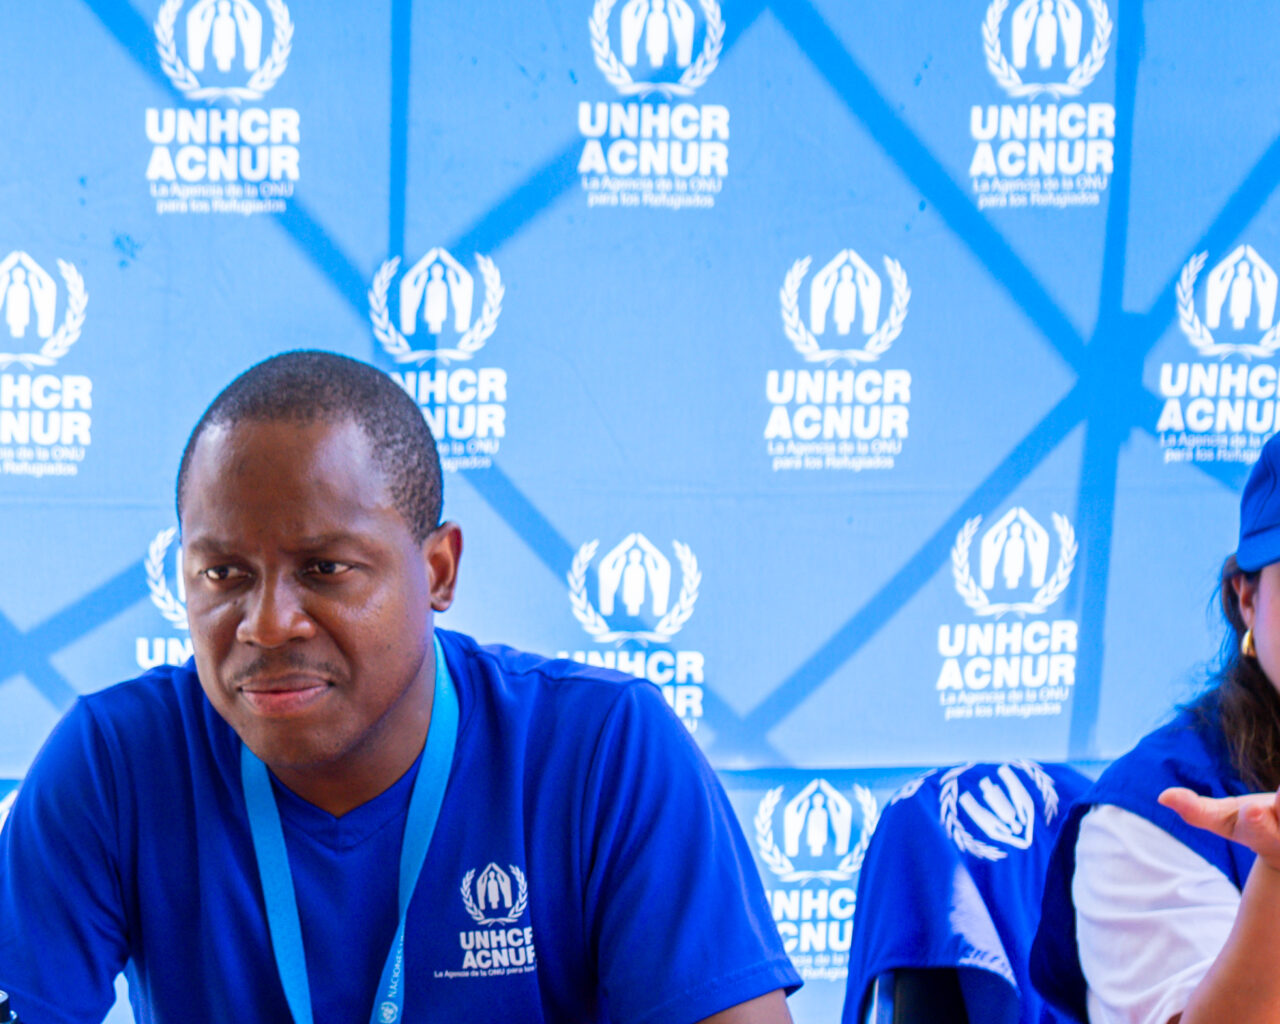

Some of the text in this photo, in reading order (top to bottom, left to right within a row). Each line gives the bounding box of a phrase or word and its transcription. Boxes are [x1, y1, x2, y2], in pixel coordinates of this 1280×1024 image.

[145, 108, 300, 144] UNHCR
[578, 101, 730, 140] UNHCR
[971, 103, 1116, 140] UNHCR
[145, 145, 300, 181] ACNUR
[577, 138, 728, 176] ACNUR
[970, 139, 1114, 177] ACNUR
[150, 182, 294, 199] La Agencia de la ONU
[581, 175, 722, 192] La Agencia de la ONU
[973, 174, 1108, 192] La Agencia de la ONU
[157, 199, 286, 215] para los Refugiados
[587, 192, 714, 210] para los Refugiados
[978, 191, 1100, 210] para los Refugiados
[766, 369, 911, 404] UNHCR
[1161, 363, 1280, 399] UNHC
[764, 405, 909, 440] ACNUR
[1156, 398, 1280, 434] ACNU
[466, 439, 500, 455] ONU
[767, 438, 902, 456] La Agencia de la ONU
[1230, 433, 1246, 448] de
[16, 446, 34, 459] de
[35, 446, 49, 460] la
[51, 445, 85, 461] ONU
[1165, 447, 1214, 464] para los
[2, 461, 78, 477] Refugiados
[773, 456, 894, 472] para los Refugiados
[938, 620, 1078, 657] UNHCR
[936, 653, 1076, 690] ACNUR
[940, 686, 1069, 706] La Agencia de la ONU
[945, 703, 1062, 721] para los Refugiados
[766, 888, 857, 921] NHC
[777, 920, 854, 954] CNU
[434, 970, 443, 978] La
[444, 969, 469, 979] Agencia
[470, 969, 479, 977] de
[480, 969, 487, 977] la
[488, 967, 505, 977] ONU
[506, 966, 523, 976] para
